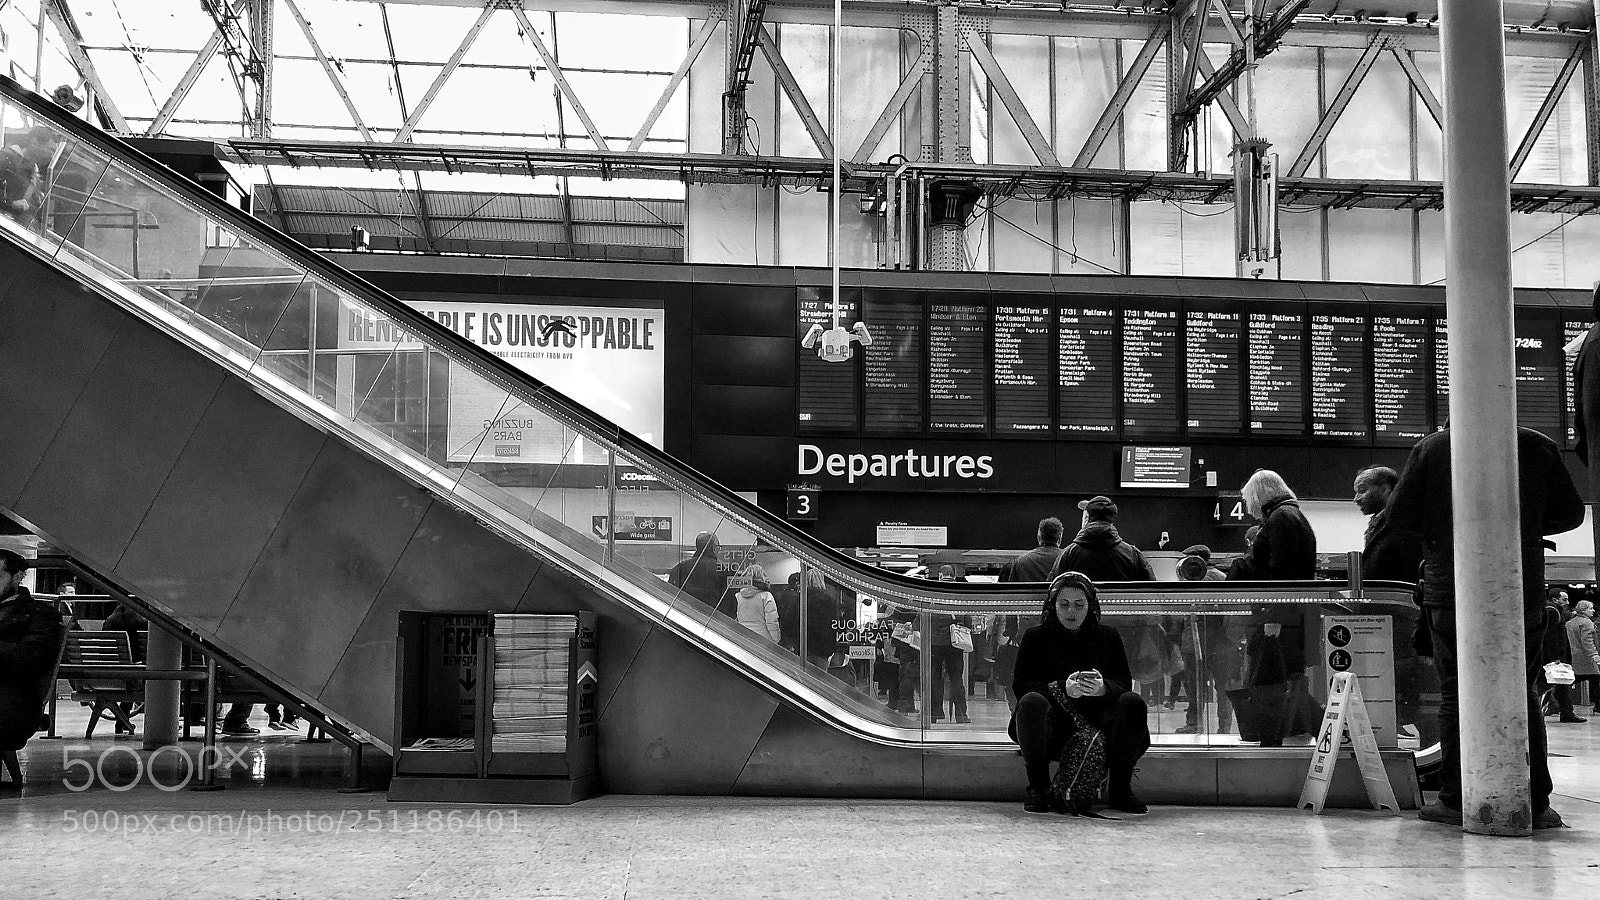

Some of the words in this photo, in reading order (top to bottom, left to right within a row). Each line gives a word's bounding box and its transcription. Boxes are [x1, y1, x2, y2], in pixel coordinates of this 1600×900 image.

[800, 310, 833, 318] Strawberr
[482, 312, 502, 346] IS
[507, 314, 655, 350] UNSTOPPABLE
[798, 444, 994, 484] Departures
[797, 495, 810, 514] 3
[1214, 502, 1220, 520] 4
[1230, 502, 1244, 520] 4
[444, 616, 463, 626] PICK
[463, 616, 473, 626] UP
